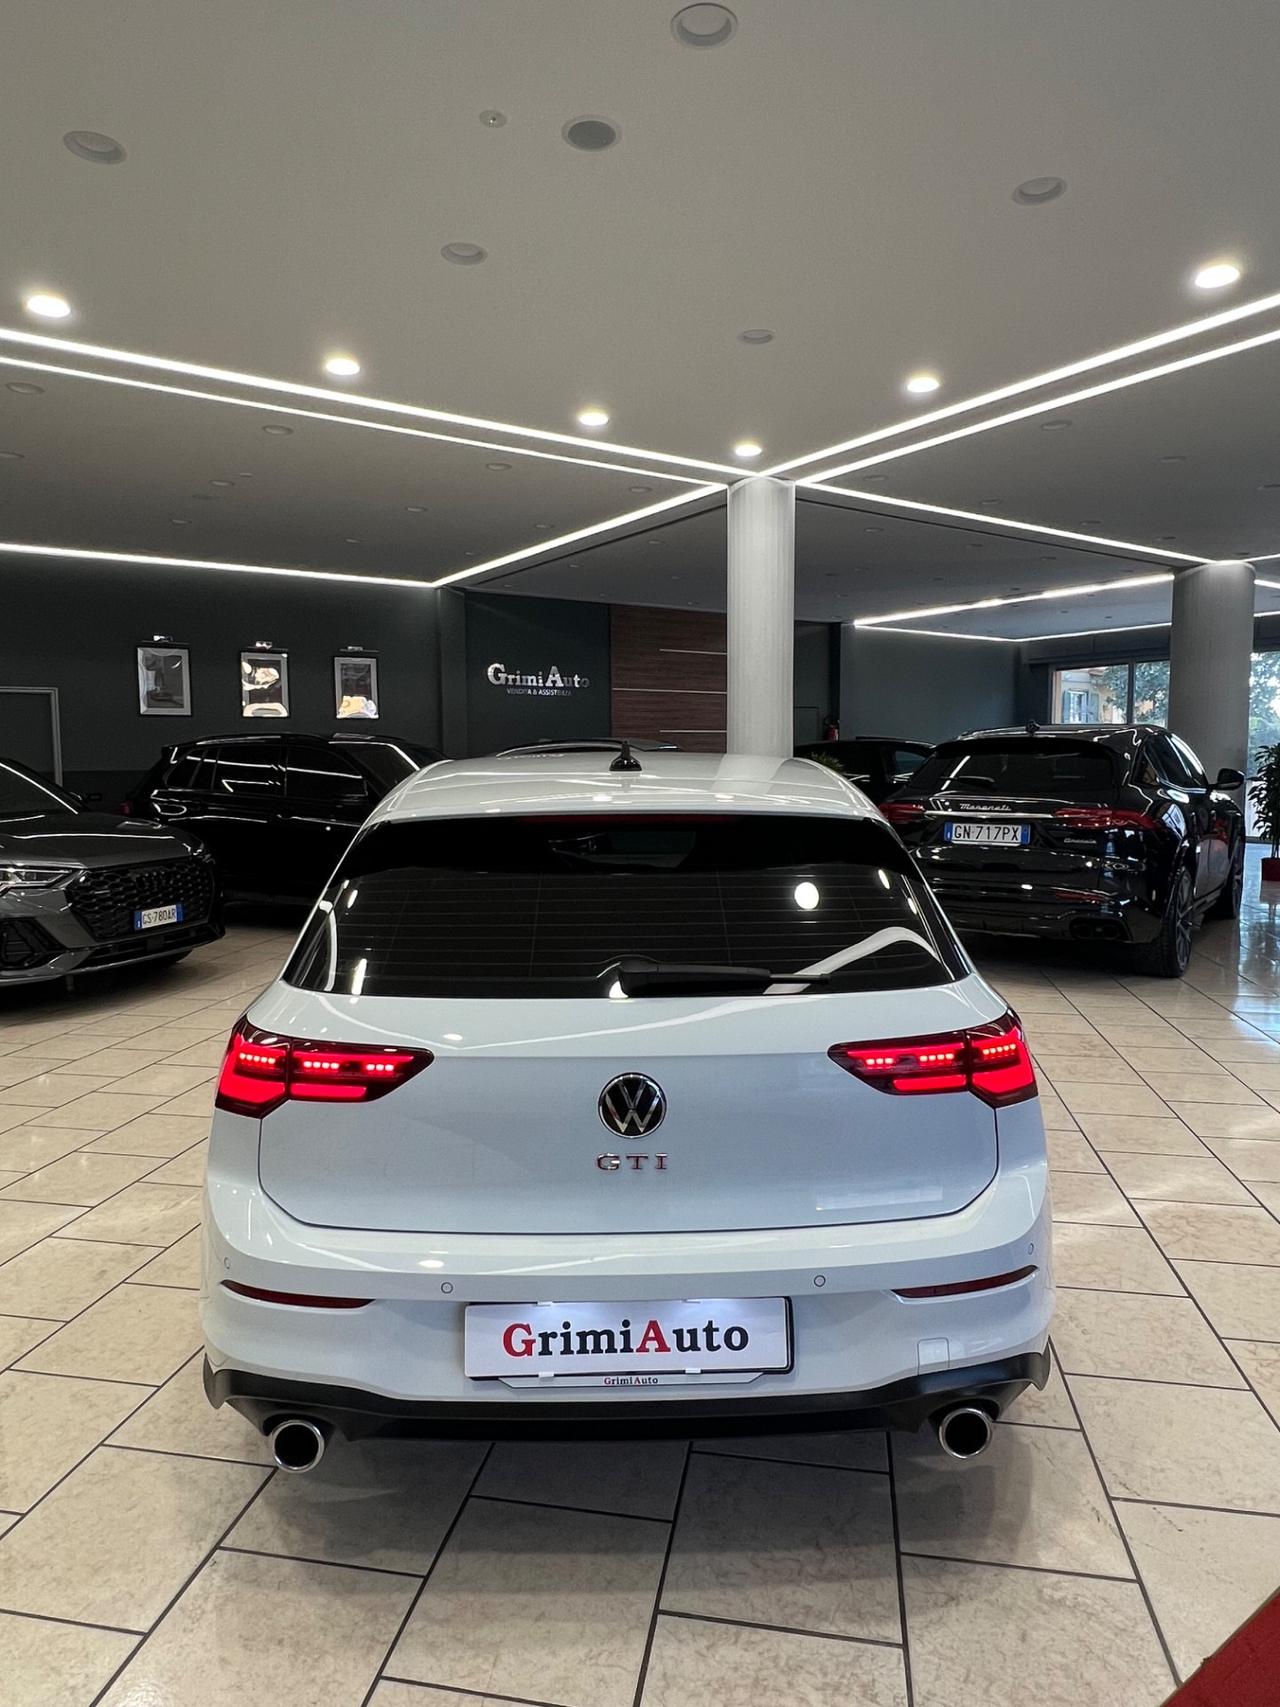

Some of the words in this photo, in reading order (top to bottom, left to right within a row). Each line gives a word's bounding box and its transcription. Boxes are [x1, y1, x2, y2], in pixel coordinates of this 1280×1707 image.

[487, 663, 590, 688] GrimiAuto
[597, 1153, 668, 1170] GTI
[502, 1319, 749, 1358] GrimiAuto
[604, 1377, 659, 1385] GrimiAuto
